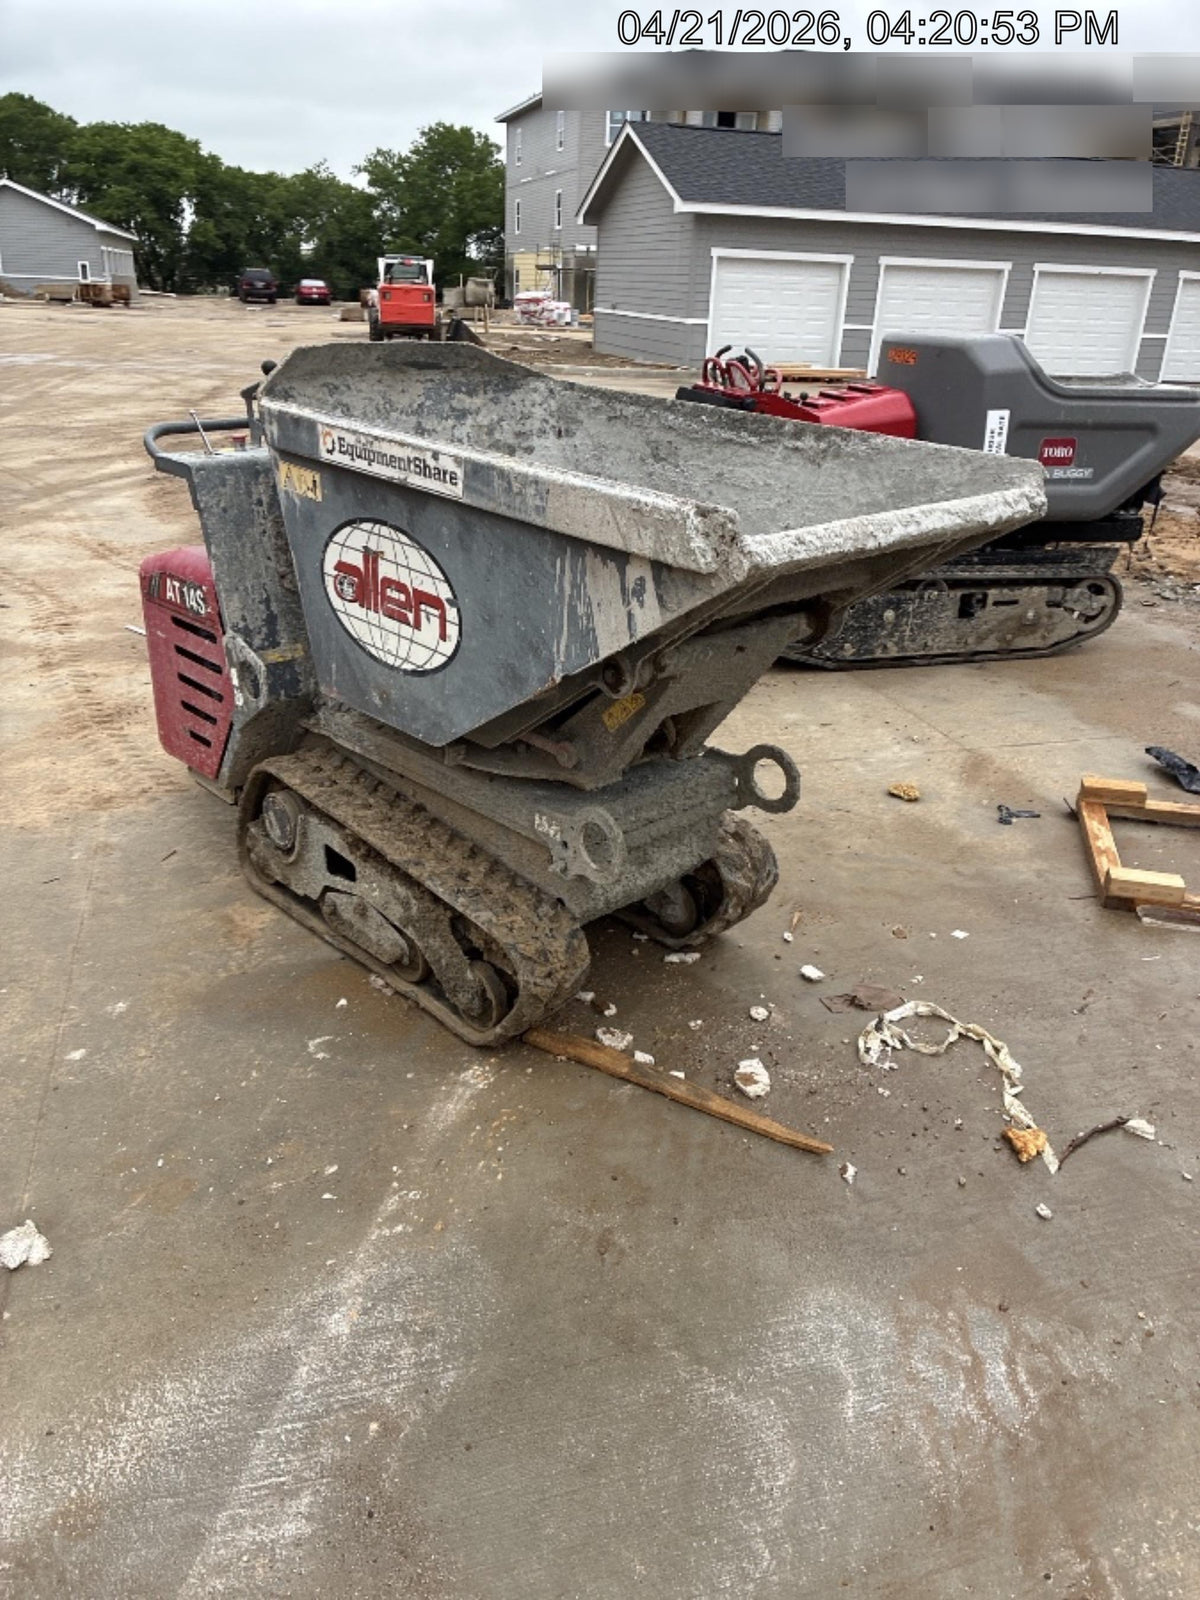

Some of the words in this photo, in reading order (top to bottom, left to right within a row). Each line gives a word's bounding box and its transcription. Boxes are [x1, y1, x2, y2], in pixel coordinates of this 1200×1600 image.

[337, 436, 459, 487] EquipmentShare
[1042, 445, 1074, 459] TORO
[333, 547, 448, 643] allen
